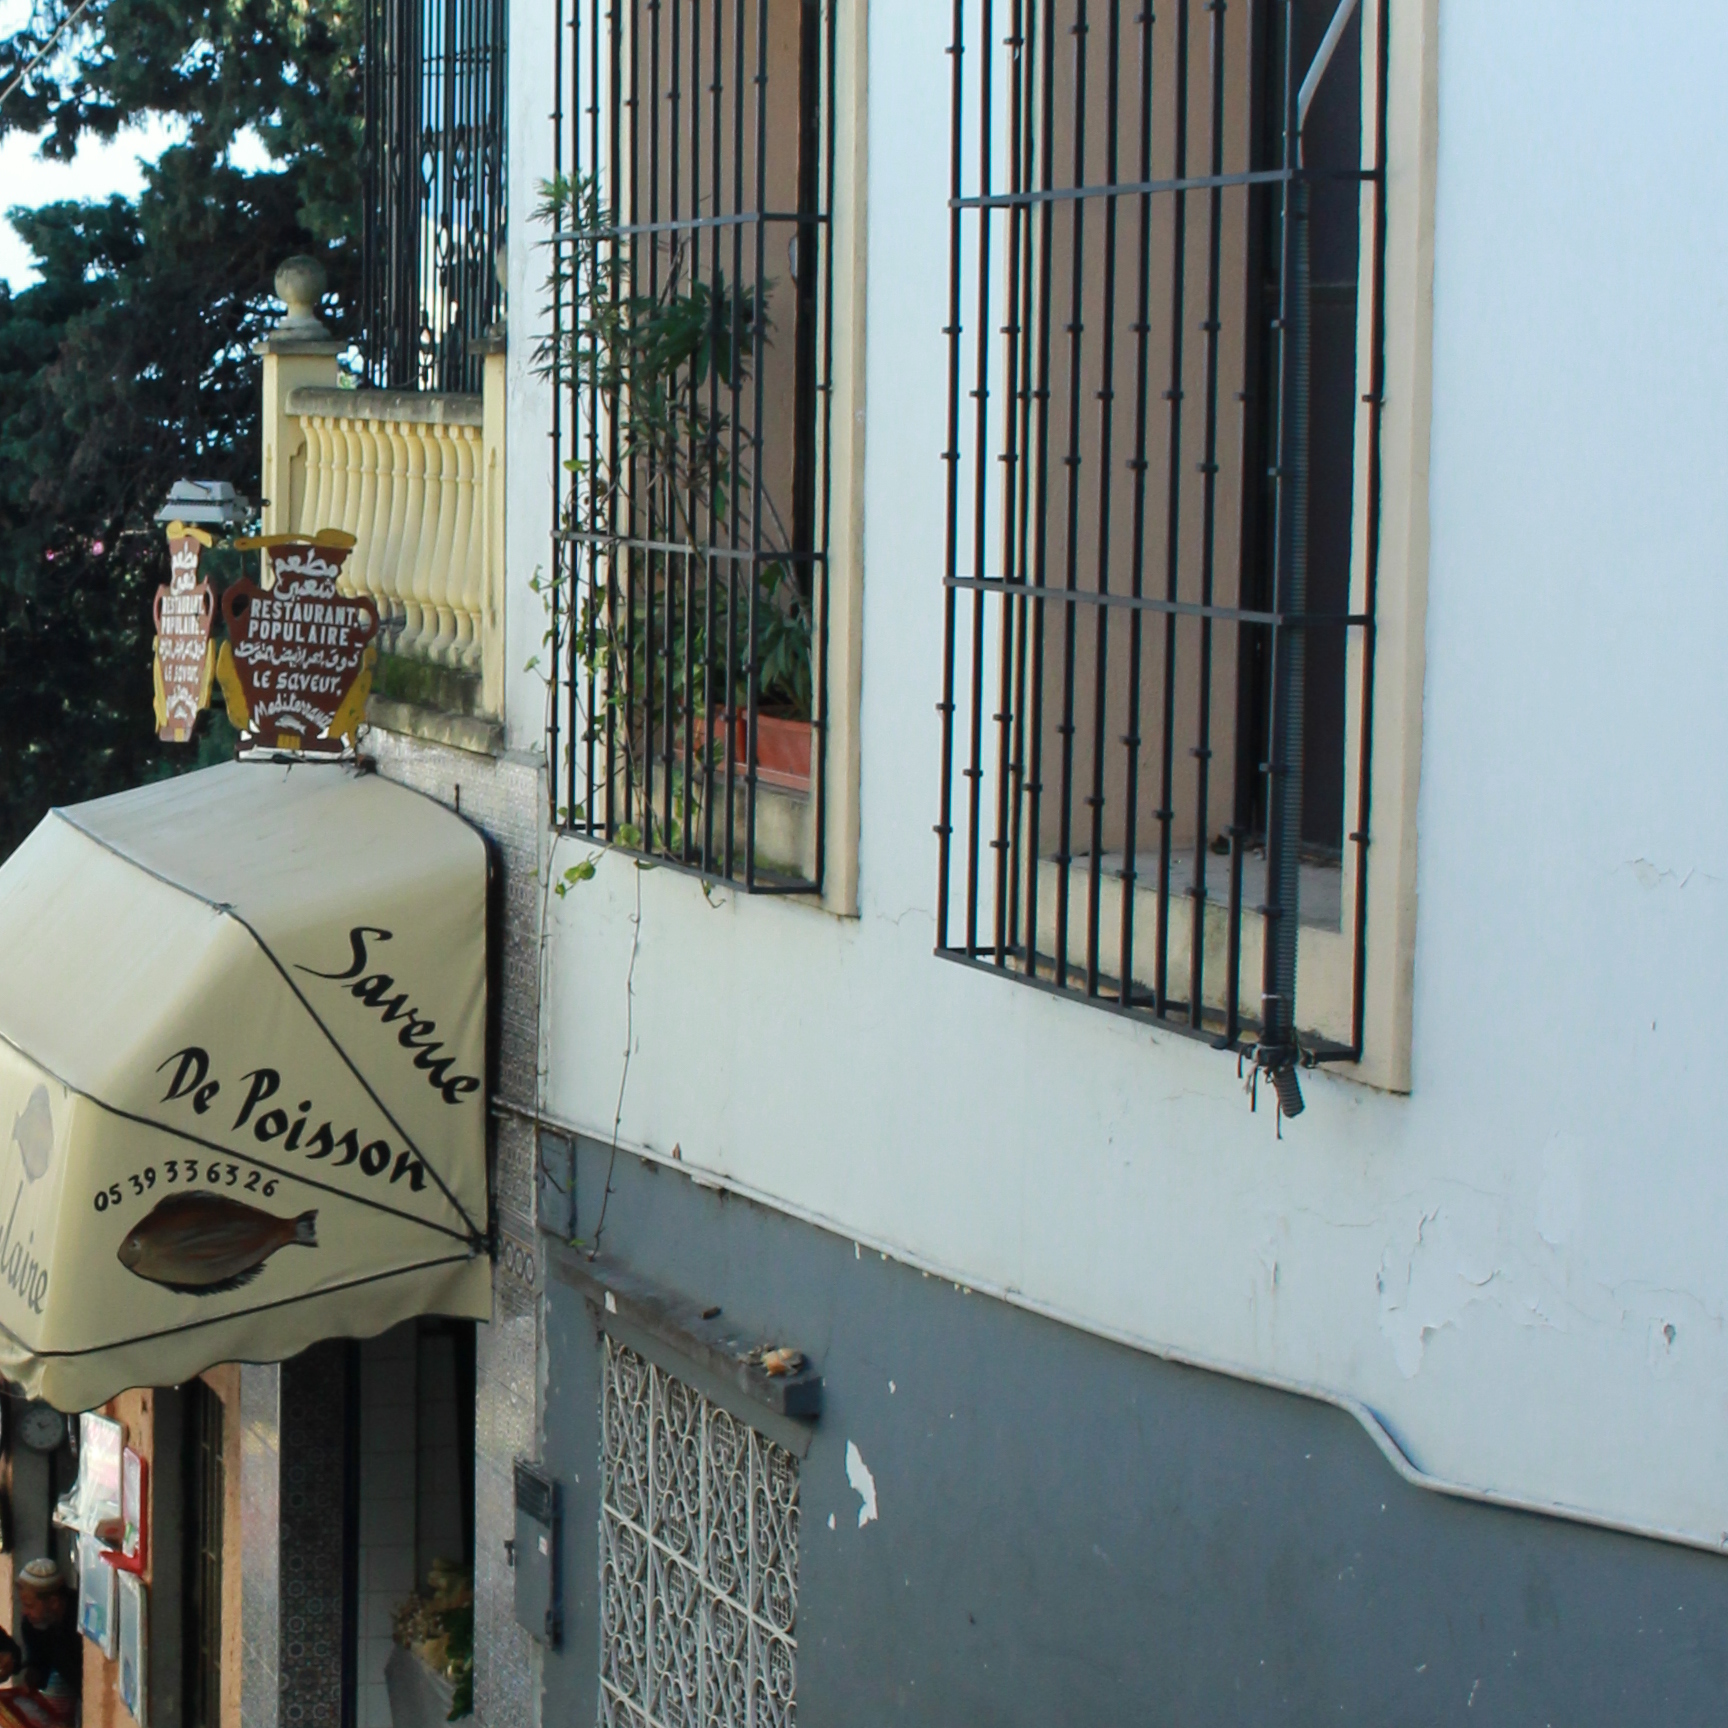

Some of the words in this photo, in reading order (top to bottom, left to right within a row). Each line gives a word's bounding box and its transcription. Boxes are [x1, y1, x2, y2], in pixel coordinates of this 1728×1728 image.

[253, 670, 272, 688] LE
[156, 1046, 220, 1114] De
[232, 1068, 427, 1192] Poisson
